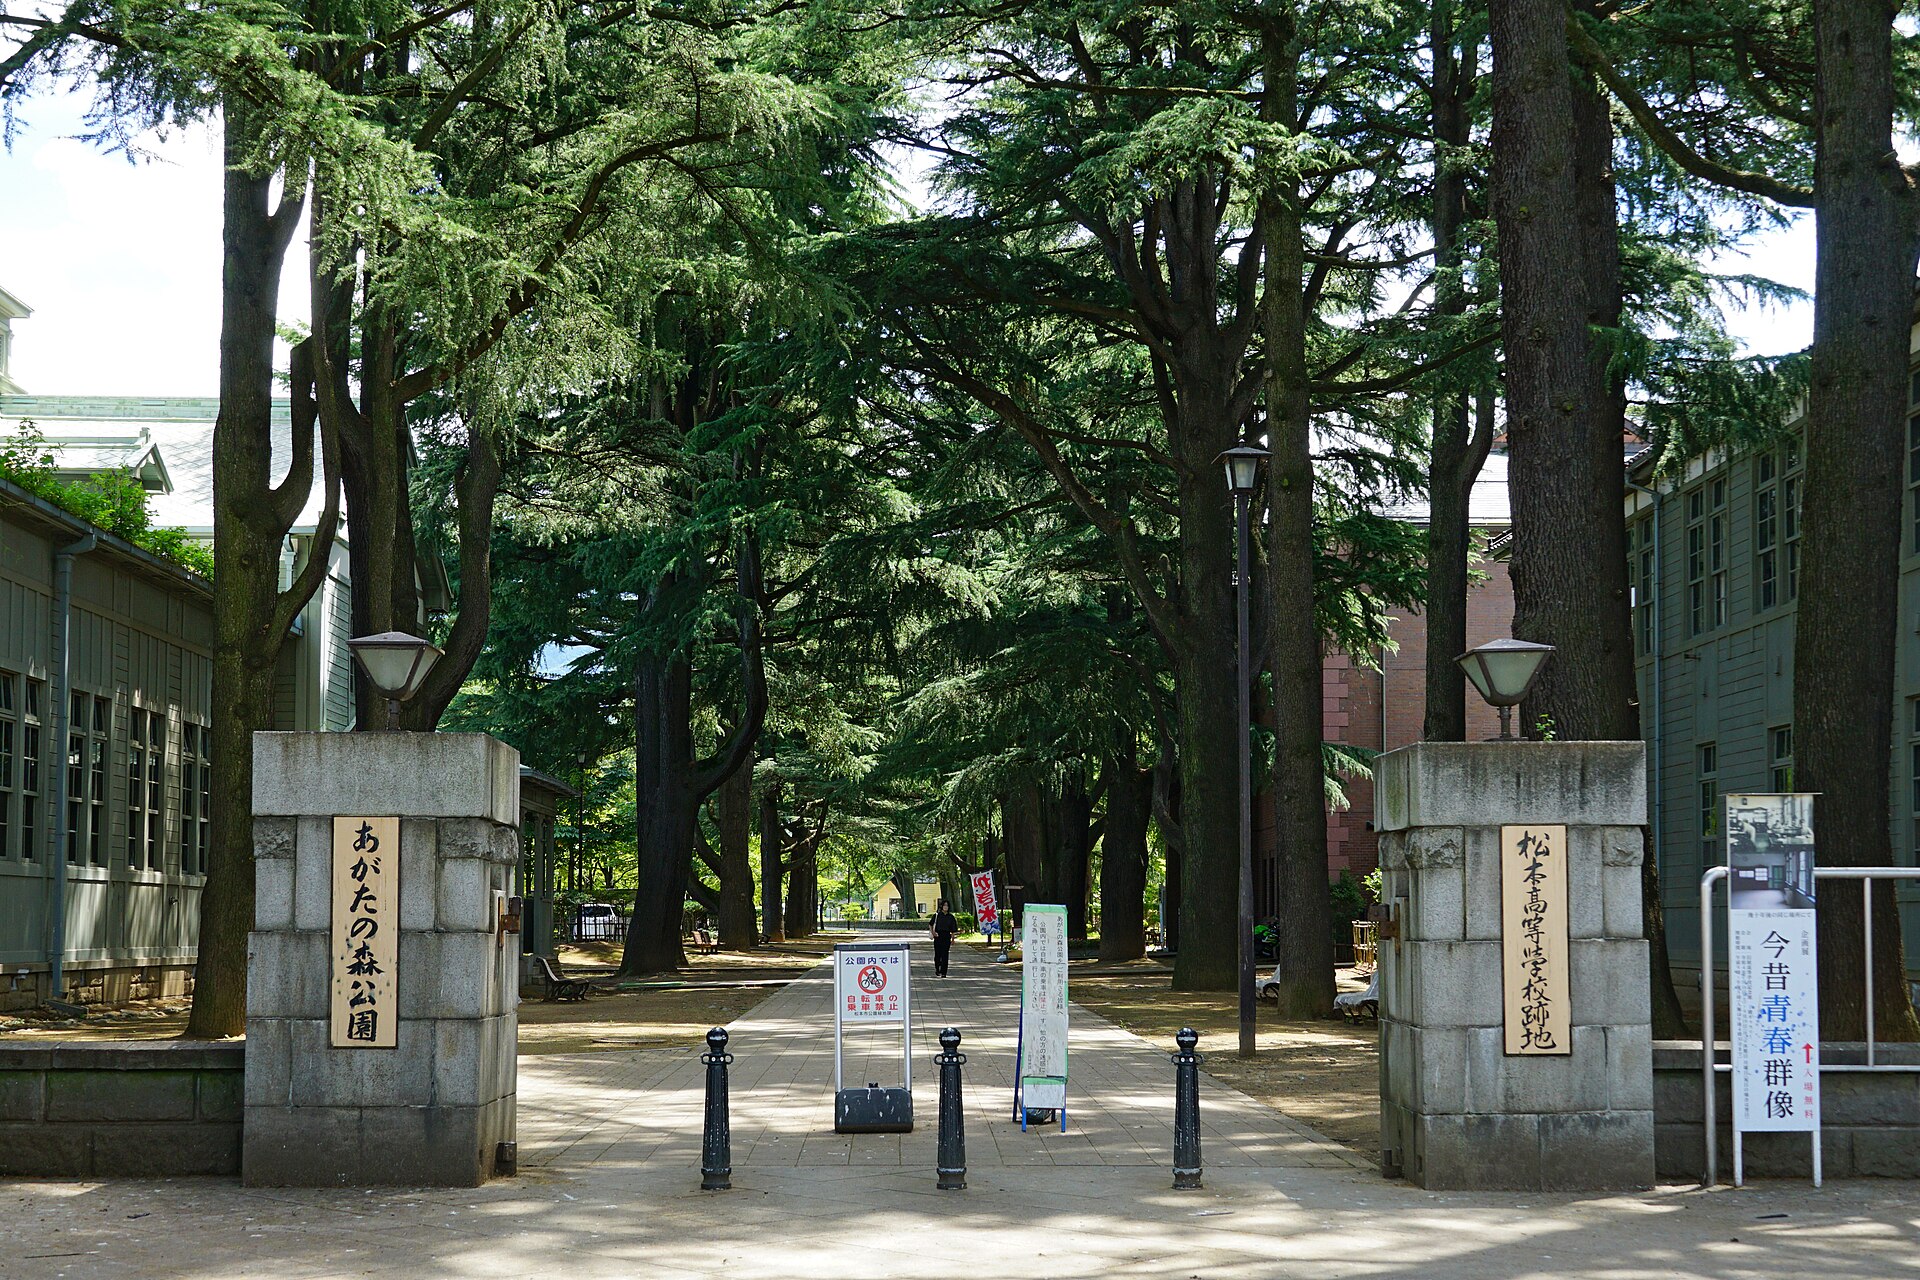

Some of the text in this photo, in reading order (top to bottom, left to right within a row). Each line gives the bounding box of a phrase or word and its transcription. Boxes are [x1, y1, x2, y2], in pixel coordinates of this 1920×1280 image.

[345, 820, 385, 1042] あがたの森公園
[845, 957, 899, 965] 公園内では
[847, 995, 898, 1003] 自転車の
[847, 1003, 899, 1011] 乗車禁止
[1760, 930, 1794, 1119] 今昔青春群像
[1803, 1068, 1814, 1120] 入場無料
